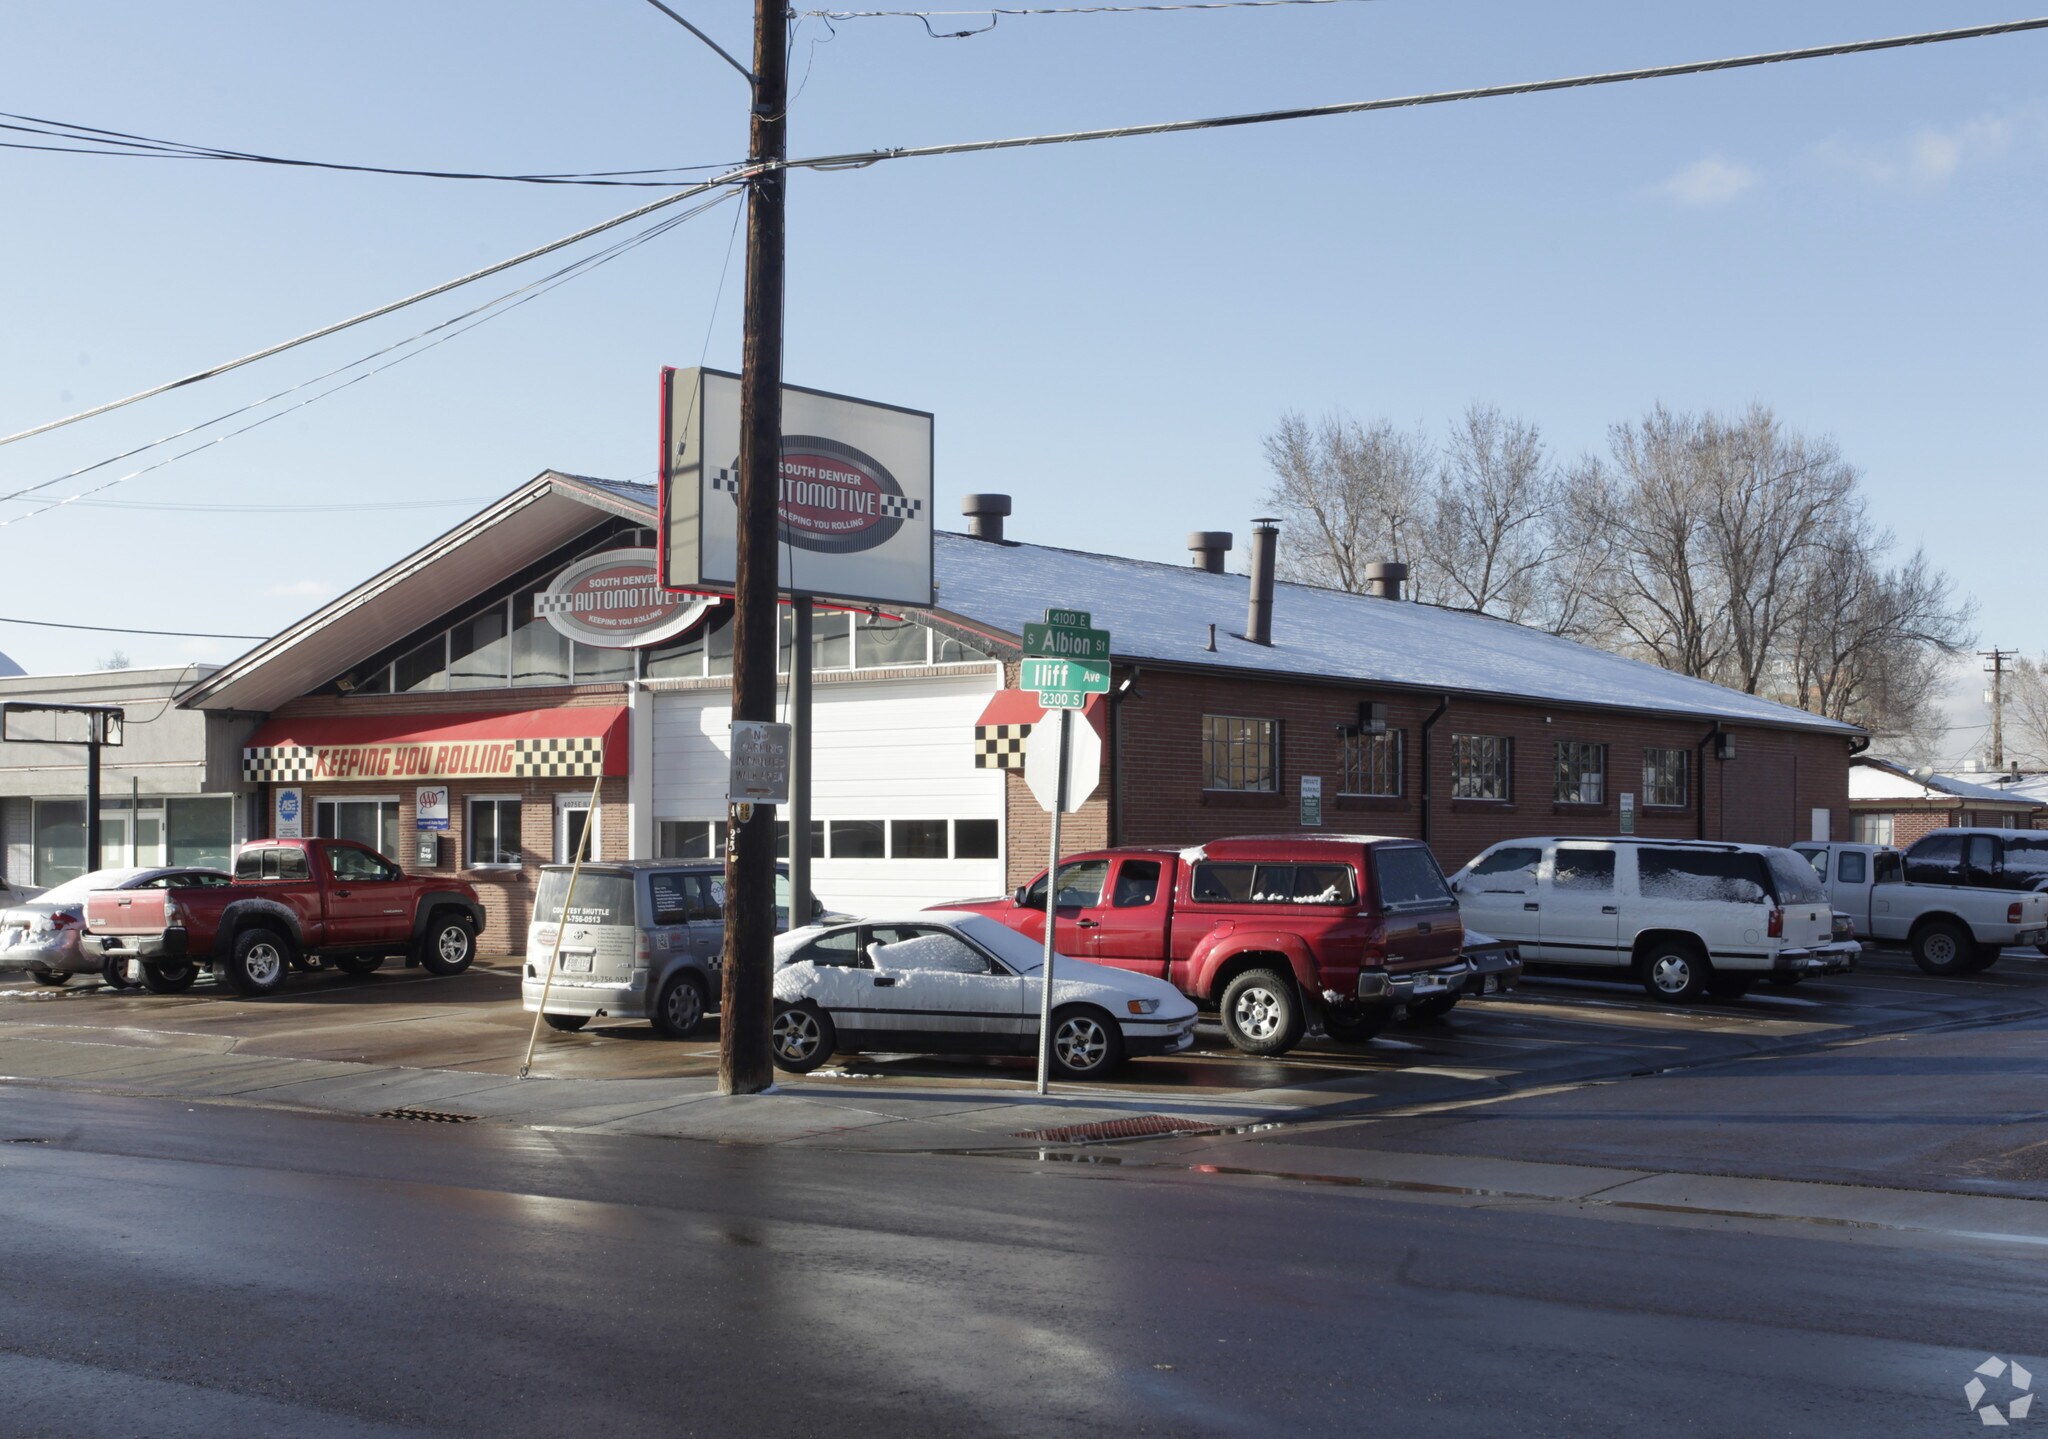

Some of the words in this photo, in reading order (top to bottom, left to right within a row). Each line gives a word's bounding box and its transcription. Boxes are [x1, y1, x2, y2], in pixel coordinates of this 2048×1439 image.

[779, 462, 815, 478] SOUTH
[818, 469, 861, 485] DENVER
[779, 478, 876, 516] TOMOTIVE
[778, 507, 812, 526] KEEPING
[813, 520, 830, 529] YOU
[832, 518, 864, 530] ROLLING
[589, 577, 620, 588] SOUTH
[575, 587, 673, 612] AUTOMOTIVE
[588, 614, 617, 626] KEEPING
[618, 617, 632, 626] YOU
[633, 608, 662, 624] ROLLING
[1053, 613, 1076, 626] 4100
[1080, 616, 1086, 627] E
[1028, 633, 1034, 645] S
[1042, 629, 1090, 655] Albion
[1096, 640, 1105, 652] St
[1034, 664, 1068, 687] Iliff
[1083, 671, 1100, 683] Ave
[1042, 693, 1068, 706] 2300
[1073, 694, 1079, 706] S
[314, 747, 392, 777] KEEPING
[392, 745, 433, 776] YOU
[434, 743, 515, 775] ROLLING
[281, 799, 296, 811] ASE
[553, 907, 581, 915] COUTESY
[582, 908, 610, 916] SHUTTLE
[559, 915, 601, 923] 33-756-0513
